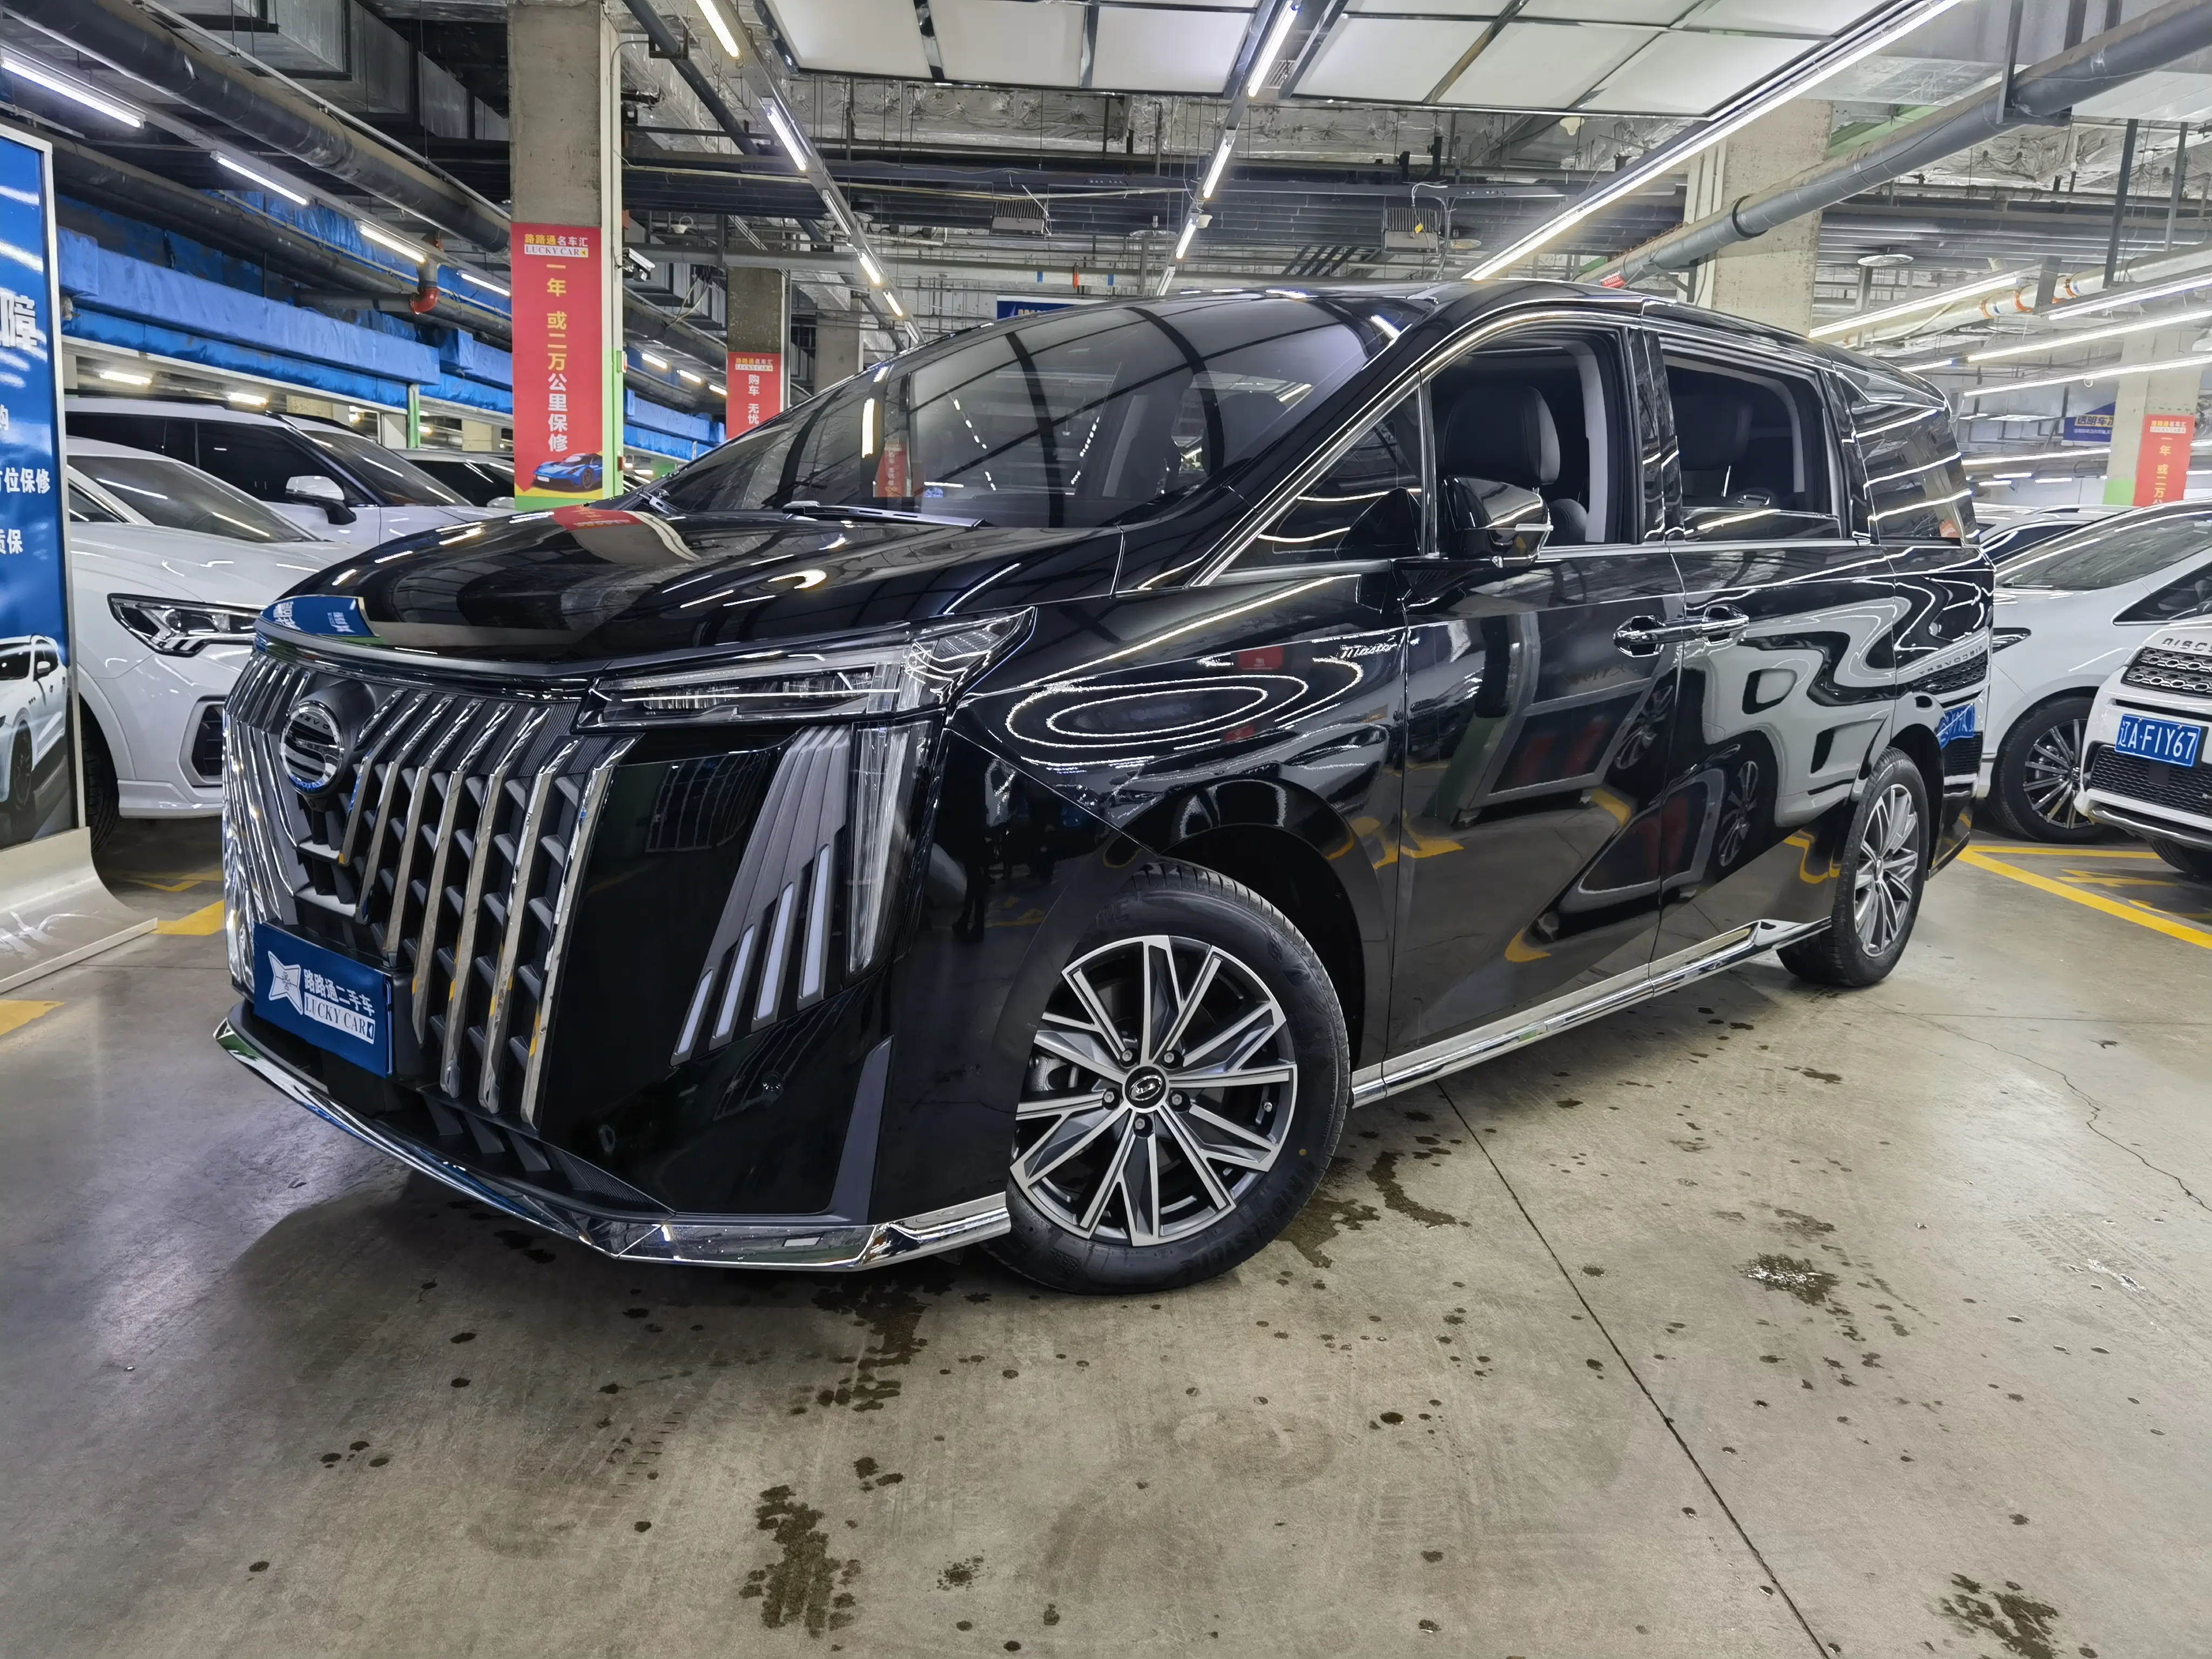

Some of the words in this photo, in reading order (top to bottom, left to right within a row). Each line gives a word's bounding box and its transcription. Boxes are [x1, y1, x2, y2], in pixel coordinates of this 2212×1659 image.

[524, 233, 588, 247] 路路通名车汇
[525, 245, 558, 255] LUCKY
[560, 247, 579, 256] CAR
[0, 467, 50, 494] 位保修
[304, 968, 375, 1016] 路路通二手车
[306, 996, 341, 1024] LUCKY
[344, 1012, 365, 1036] CAR
